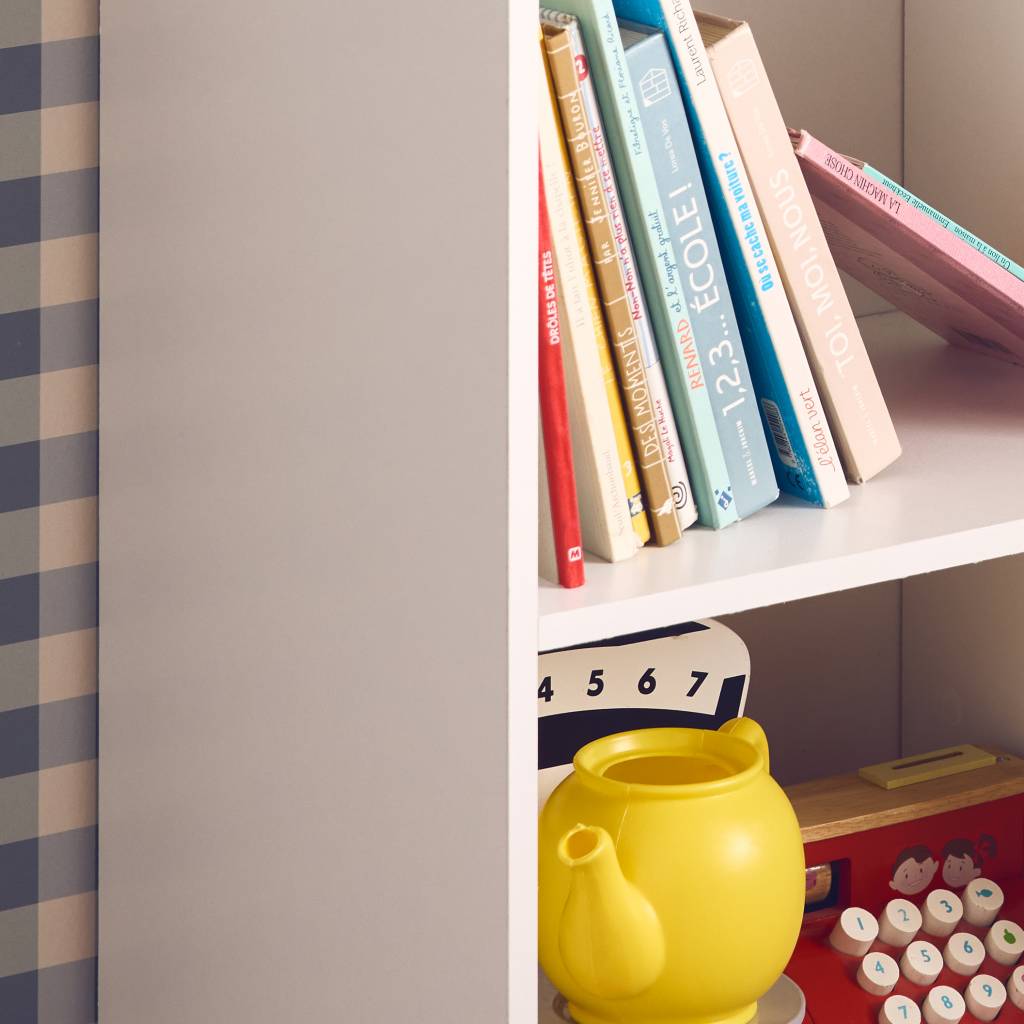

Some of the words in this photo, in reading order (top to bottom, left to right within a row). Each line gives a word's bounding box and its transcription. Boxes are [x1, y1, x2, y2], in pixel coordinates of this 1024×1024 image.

[684, 35, 706, 86] Laurent
[592, 125, 606, 168] mettre
[602, 170, 611, 183] se
[724, 160, 745, 204] voiture
[825, 153, 854, 181] CHOSE
[584, 158, 606, 223] JENNIFER
[853, 174, 888, 206] MACHIN
[882, 179, 911, 203] Eeckhout
[889, 196, 901, 215] LA
[610, 198, 619, 220] rien
[738, 202, 752, 221] ma
[769, 168, 811, 250] NOUS
[911, 198, 950, 229] Emmanuelle
[615, 223, 628, 245] plus
[648, 209, 671, 246] gratuit
[745, 222, 764, 258] cache
[954, 226, 976, 244] maison
[542, 250, 554, 283] TÊTES
[619, 248, 630, 265] n'a
[672, 197, 720, 314] ÉCOLE
[756, 258, 769, 274] se
[987, 248, 1001, 263] lion
[1001, 256, 1011, 270] Un
[658, 250, 679, 297] l'argent
[760, 273, 774, 292] Où
[800, 247, 834, 316] MOI,
[545, 284, 557, 300] DE
[625, 268, 642, 321] Non-Non
[670, 303, 682, 313] et
[546, 300, 561, 345] DRÔLES
[677, 319, 704, 390] RENARD
[825, 315, 854, 380] TOI,
[618, 327, 651, 417] MOMENTS
[800, 387, 818, 421] vert
[640, 423, 660, 458] DES
[661, 426, 669, 436] Le
[812, 420, 836, 473] l'élan
[538, 676, 554, 702] 4
[586, 669, 605, 697] 5
[637, 667, 657, 695] 6
[686, 670, 709, 698] 7
[856, 917, 865, 931] 1
[897, 908, 910, 922] 2
[940, 899, 953, 913] 3
[875, 960, 885, 974] 4
[920, 949, 931, 963] 5
[963, 940, 974, 954] 6
[897, 1005, 908, 1020] 7
[940, 995, 953, 1009] 8
[982, 984, 993, 997] 9
